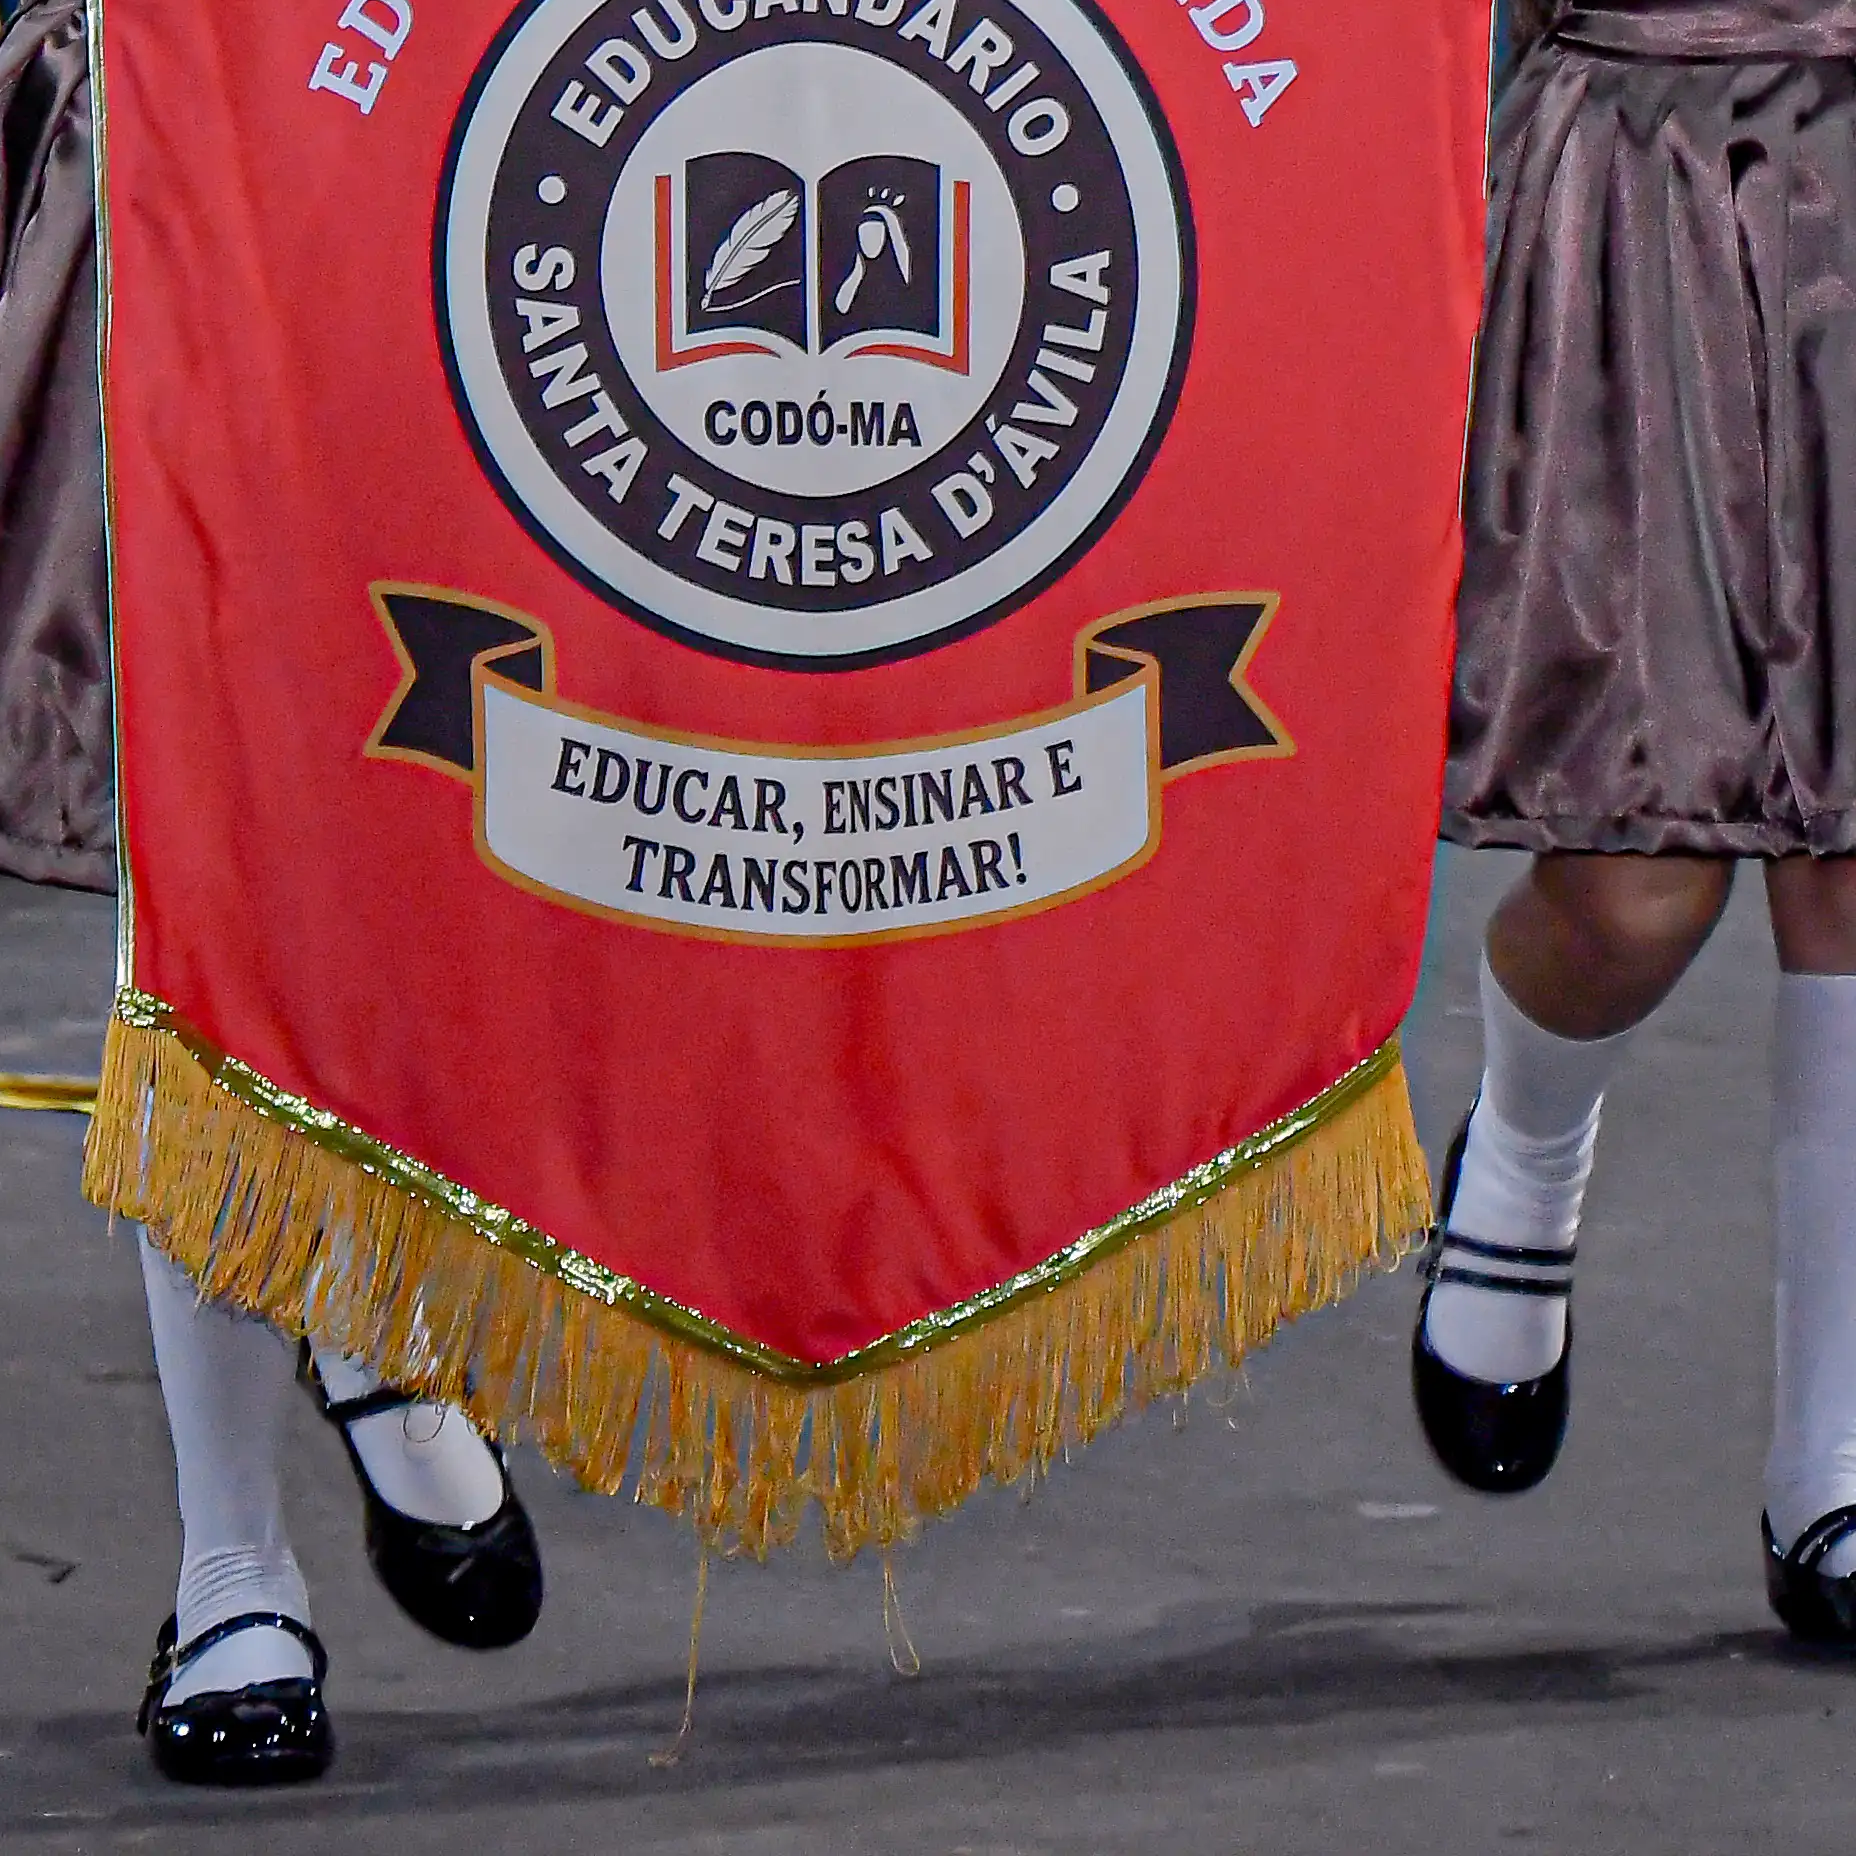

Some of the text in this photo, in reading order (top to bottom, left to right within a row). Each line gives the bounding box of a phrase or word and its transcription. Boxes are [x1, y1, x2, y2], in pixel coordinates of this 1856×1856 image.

[511, 241, 650, 506] SANTA
[655, 471, 936, 588] TERESA
[702, 388, 924, 449] CODÓ-MA
[549, 735, 1084, 847] EDUCAR, ENSINAR E
[621, 830, 1028, 916] TRANSFORMAR!
